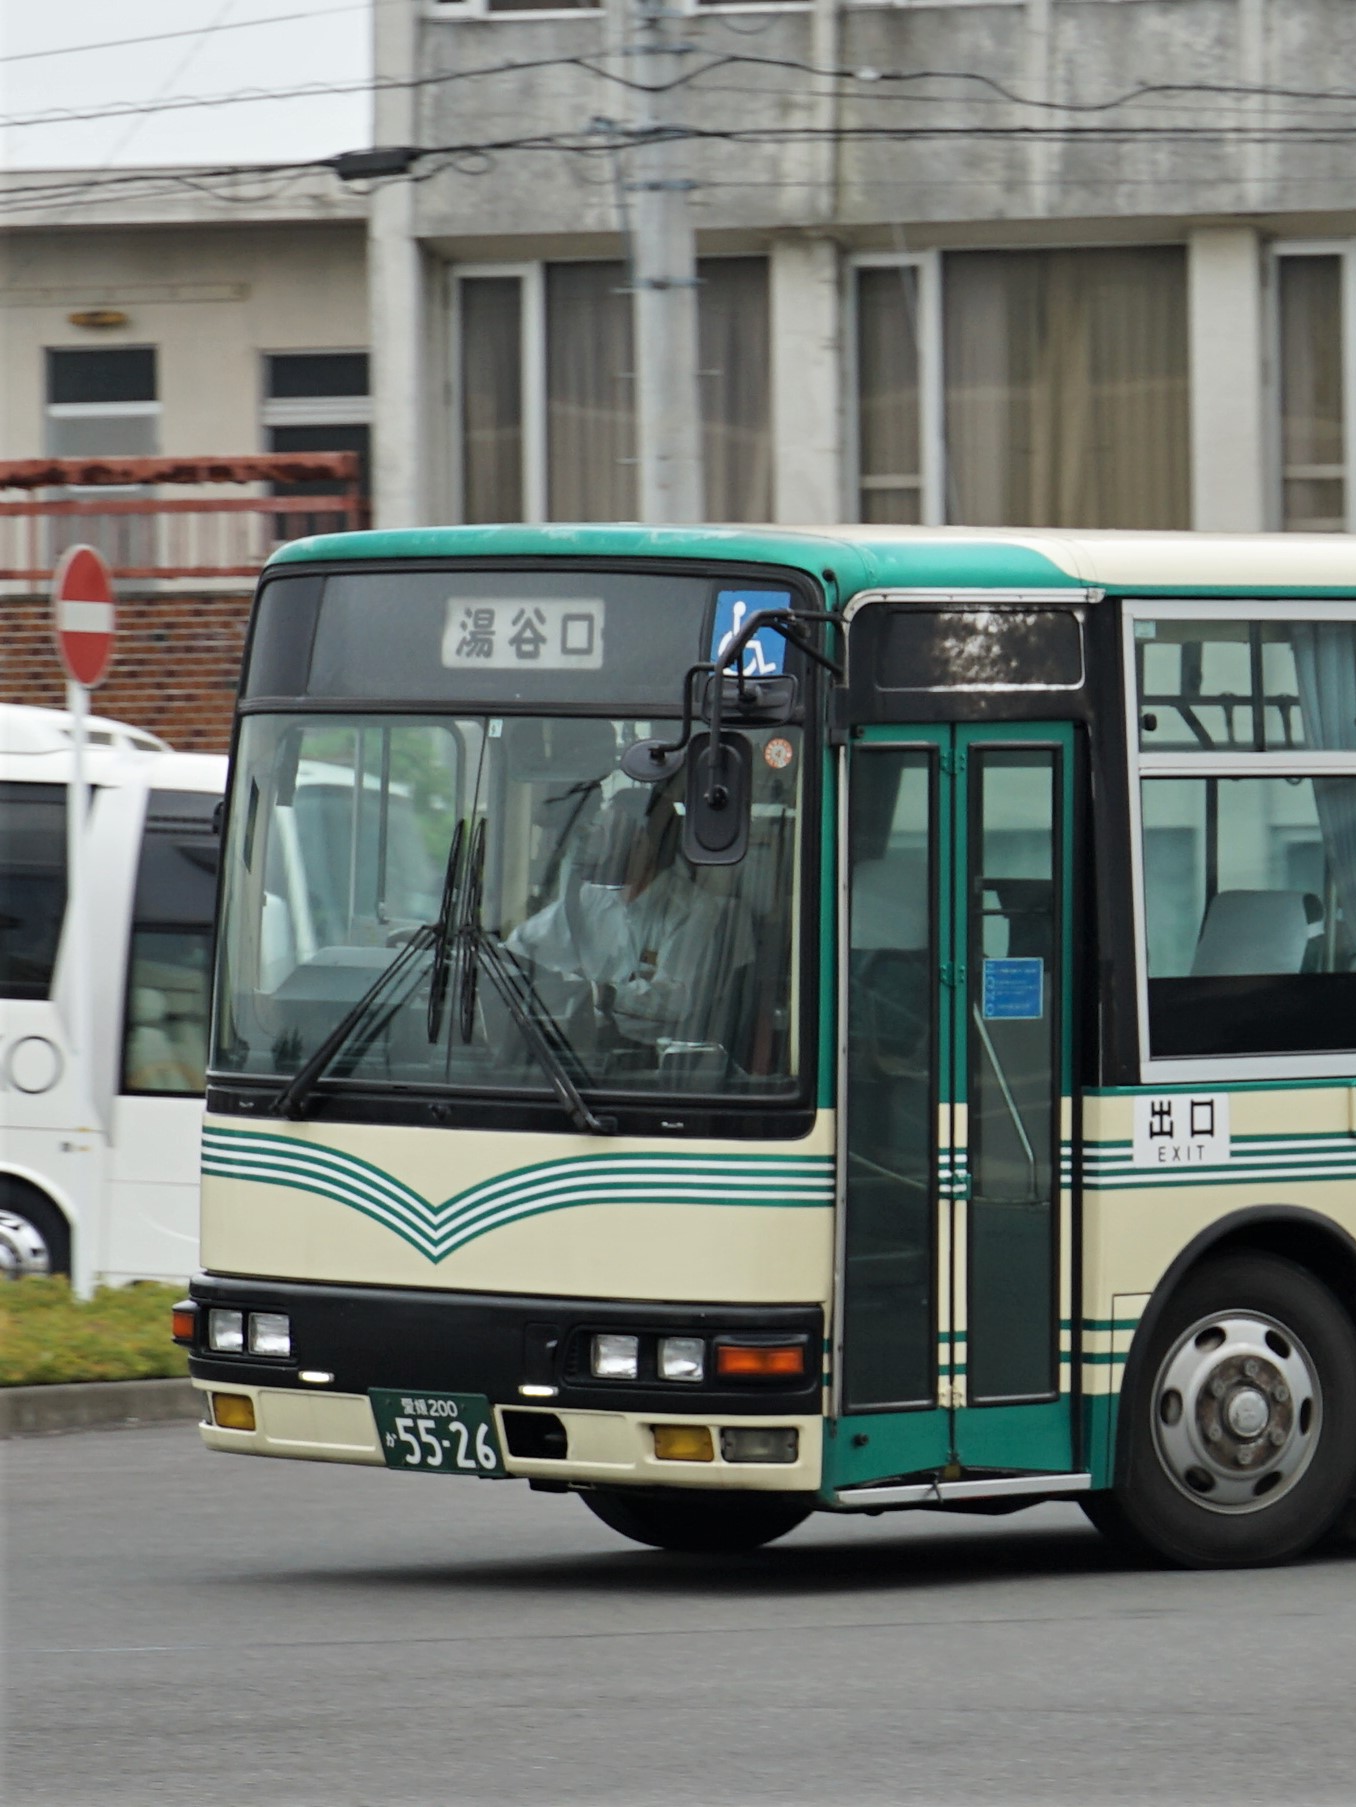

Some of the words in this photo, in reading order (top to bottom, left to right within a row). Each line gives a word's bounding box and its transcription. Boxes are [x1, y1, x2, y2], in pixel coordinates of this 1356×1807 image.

[455, 606, 595, 661] 湯谷口
[1148, 1098, 1215, 1140] 出口
[1157, 1145, 1205, 1162] EXIT
[395, 1417, 497, 1469] 55-26
